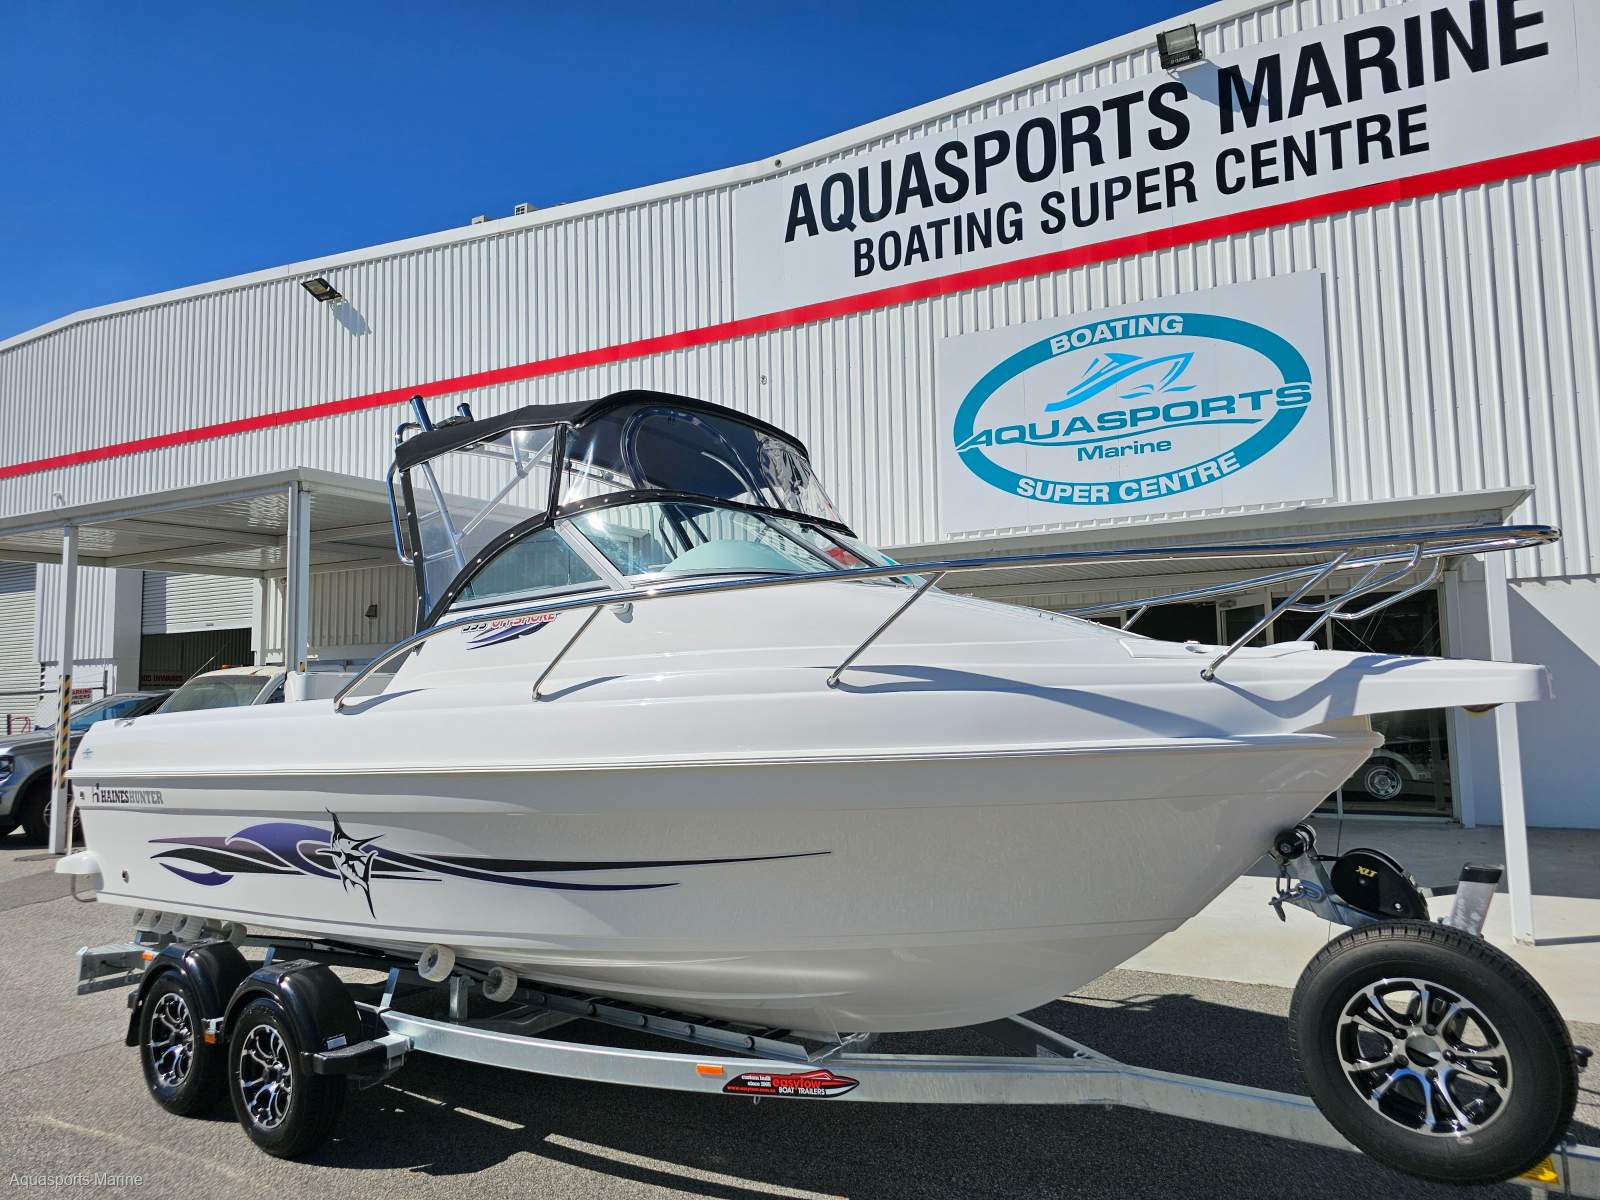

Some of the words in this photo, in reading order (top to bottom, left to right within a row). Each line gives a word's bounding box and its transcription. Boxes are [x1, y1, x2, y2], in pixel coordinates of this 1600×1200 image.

[784, 81, 1191, 243] AQUASPORTS
[1217, 0, 1549, 135] MARINE
[854, 201, 1023, 278] BOATING
[1040, 160, 1198, 235] SUPER
[1215, 103, 1430, 195] CENTRE
[1050, 315, 1184, 356] BOATING
[957, 383, 1312, 452] AQUASPORTS
[1077, 439, 1172, 462] Marine
[1016, 477, 1110, 503] SUPER
[1119, 451, 1242, 497] CENTRE
[1355, 865, 1378, 878] XLT
[778, 1086, 794, 1094] BOAT
[798, 1087, 825, 1095] TRAILERS
